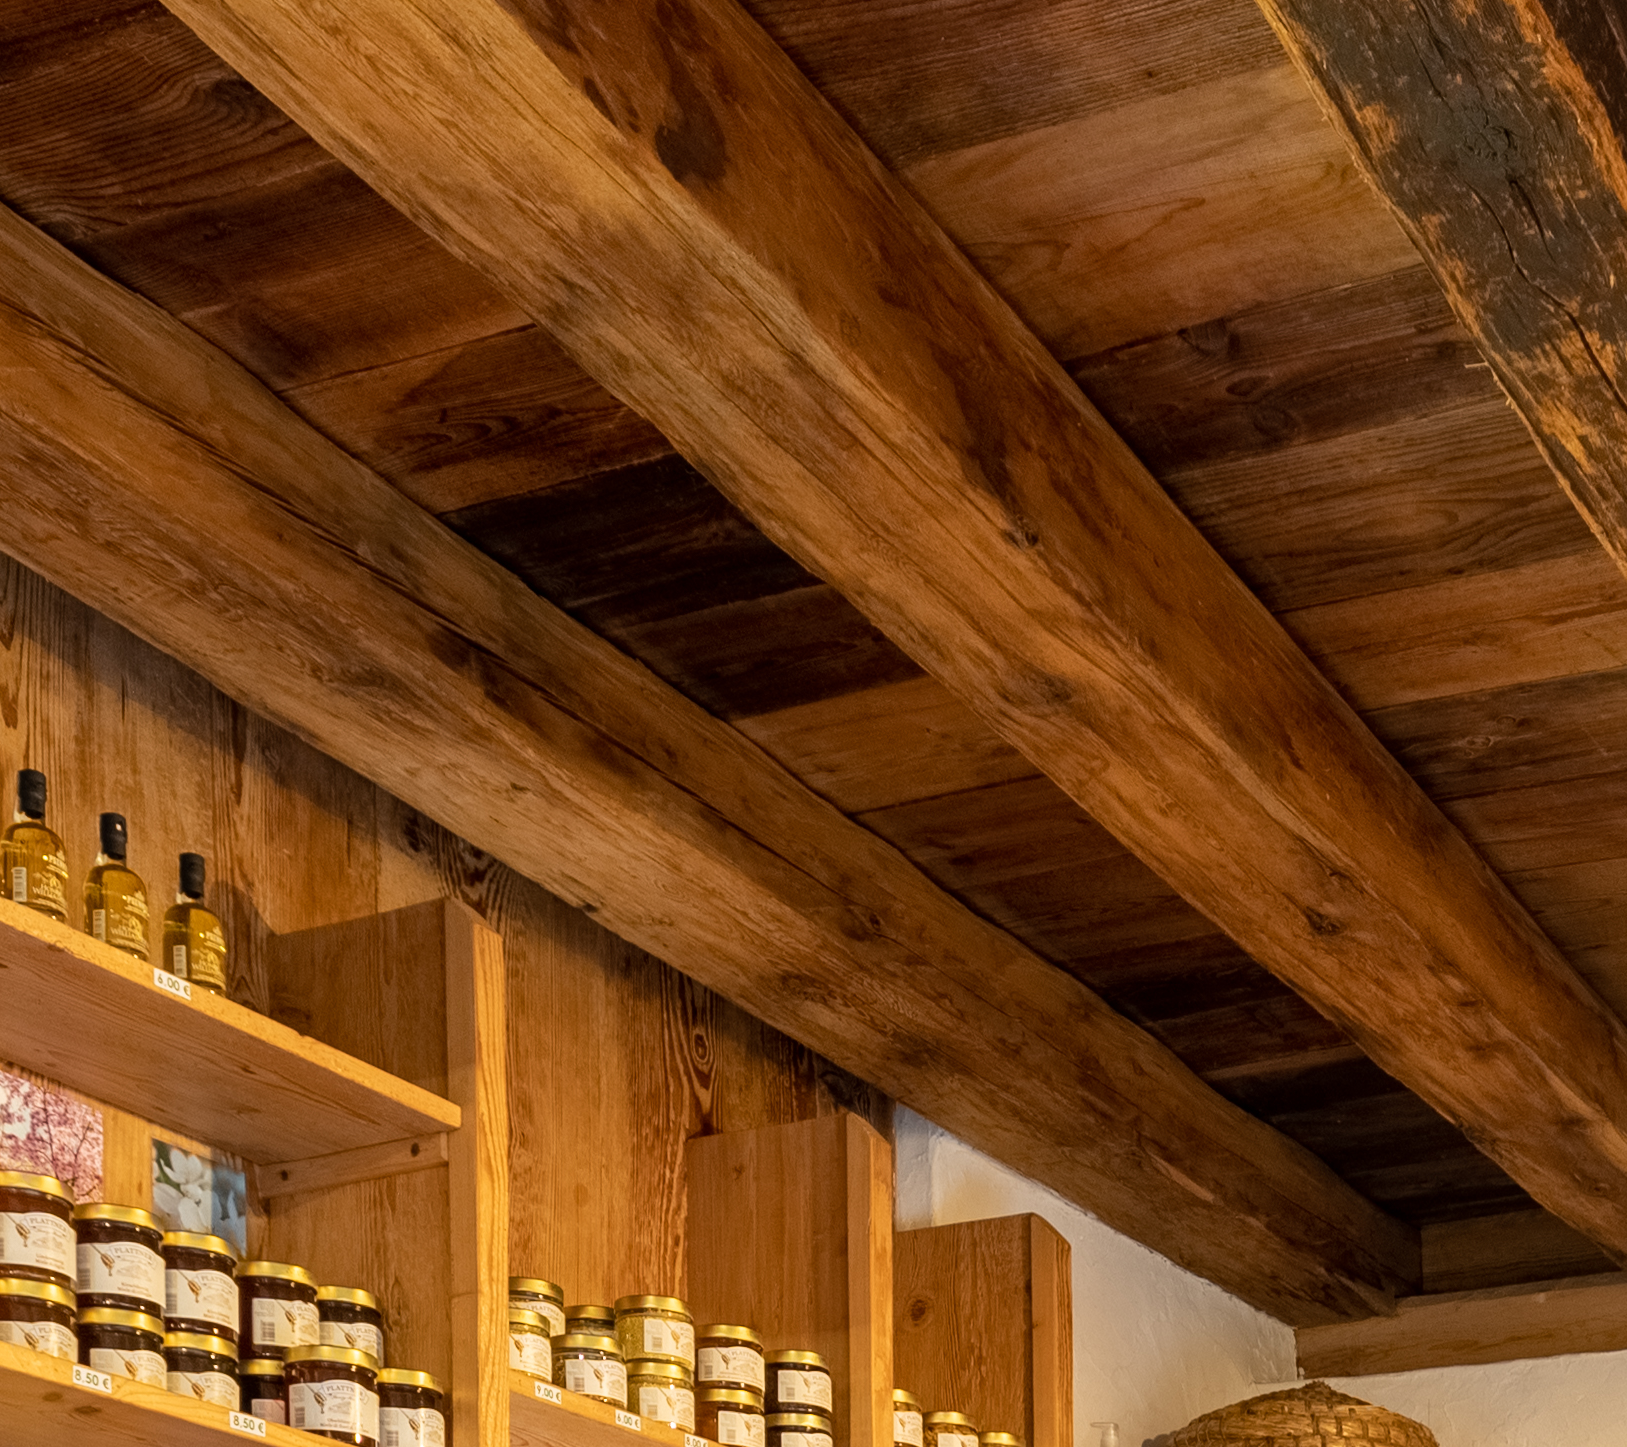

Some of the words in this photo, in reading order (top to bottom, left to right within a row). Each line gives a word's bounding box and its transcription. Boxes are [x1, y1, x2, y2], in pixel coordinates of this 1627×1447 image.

[75, 1370, 99, 1386] 8,50
[102, 1377, 109, 1389] €
[233, 1415, 255, 1431] 8,50
[258, 1422, 265, 1434] €
